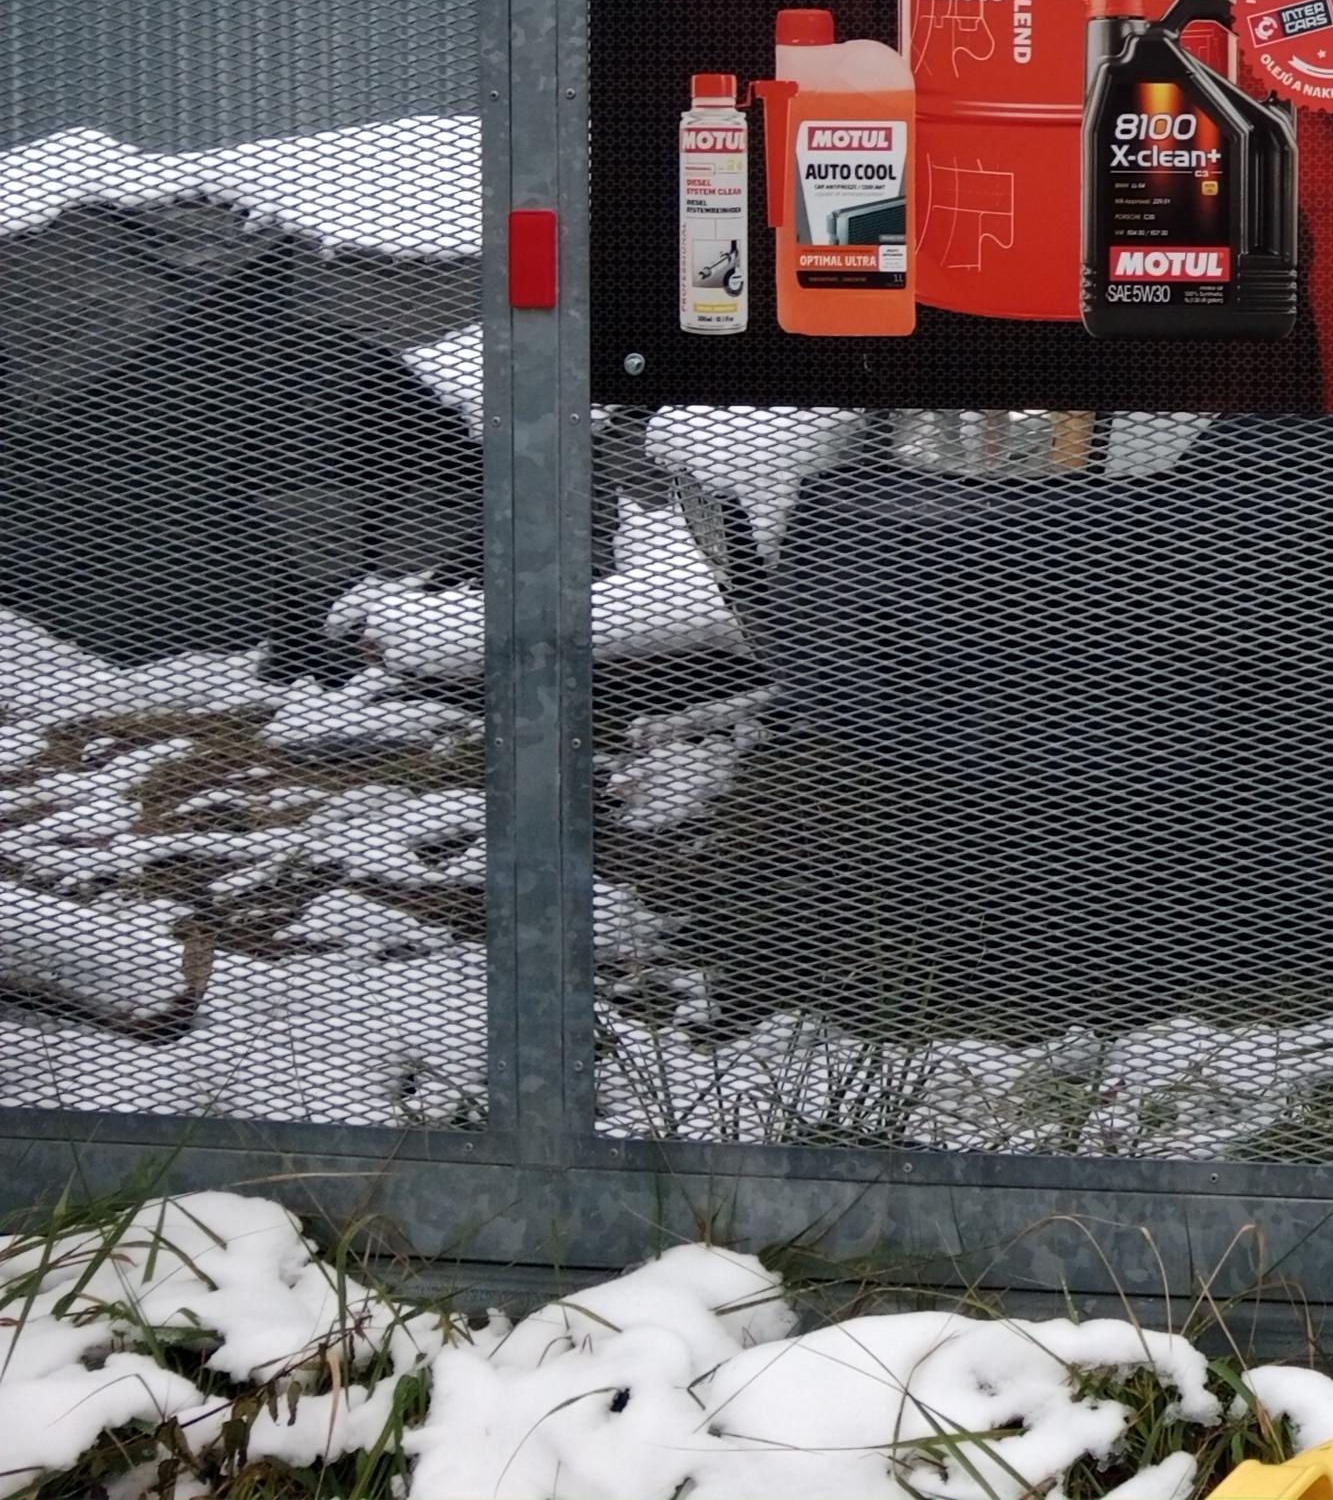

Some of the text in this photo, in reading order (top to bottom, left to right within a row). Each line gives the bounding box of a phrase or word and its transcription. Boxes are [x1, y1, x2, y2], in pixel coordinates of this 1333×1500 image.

[1281, 1, 1326, 24] INTER
[1285, 13, 1328, 34] CARS
[1292, 81, 1301, 92] A
[1115, 113, 1197, 141] 8100
[812, 130, 888, 148] MOTUL
[1110, 144, 1221, 168] X-clean+
[805, 164, 896, 180] AUTO COOL
[800, 255, 842, 266] OPTIMAL
[845, 255, 877, 267] ULTRA
[1115, 252, 1223, 276] MOTUL
[1107, 285, 1134, 302] SAE
[1134, 285, 1171, 302] 5W30
